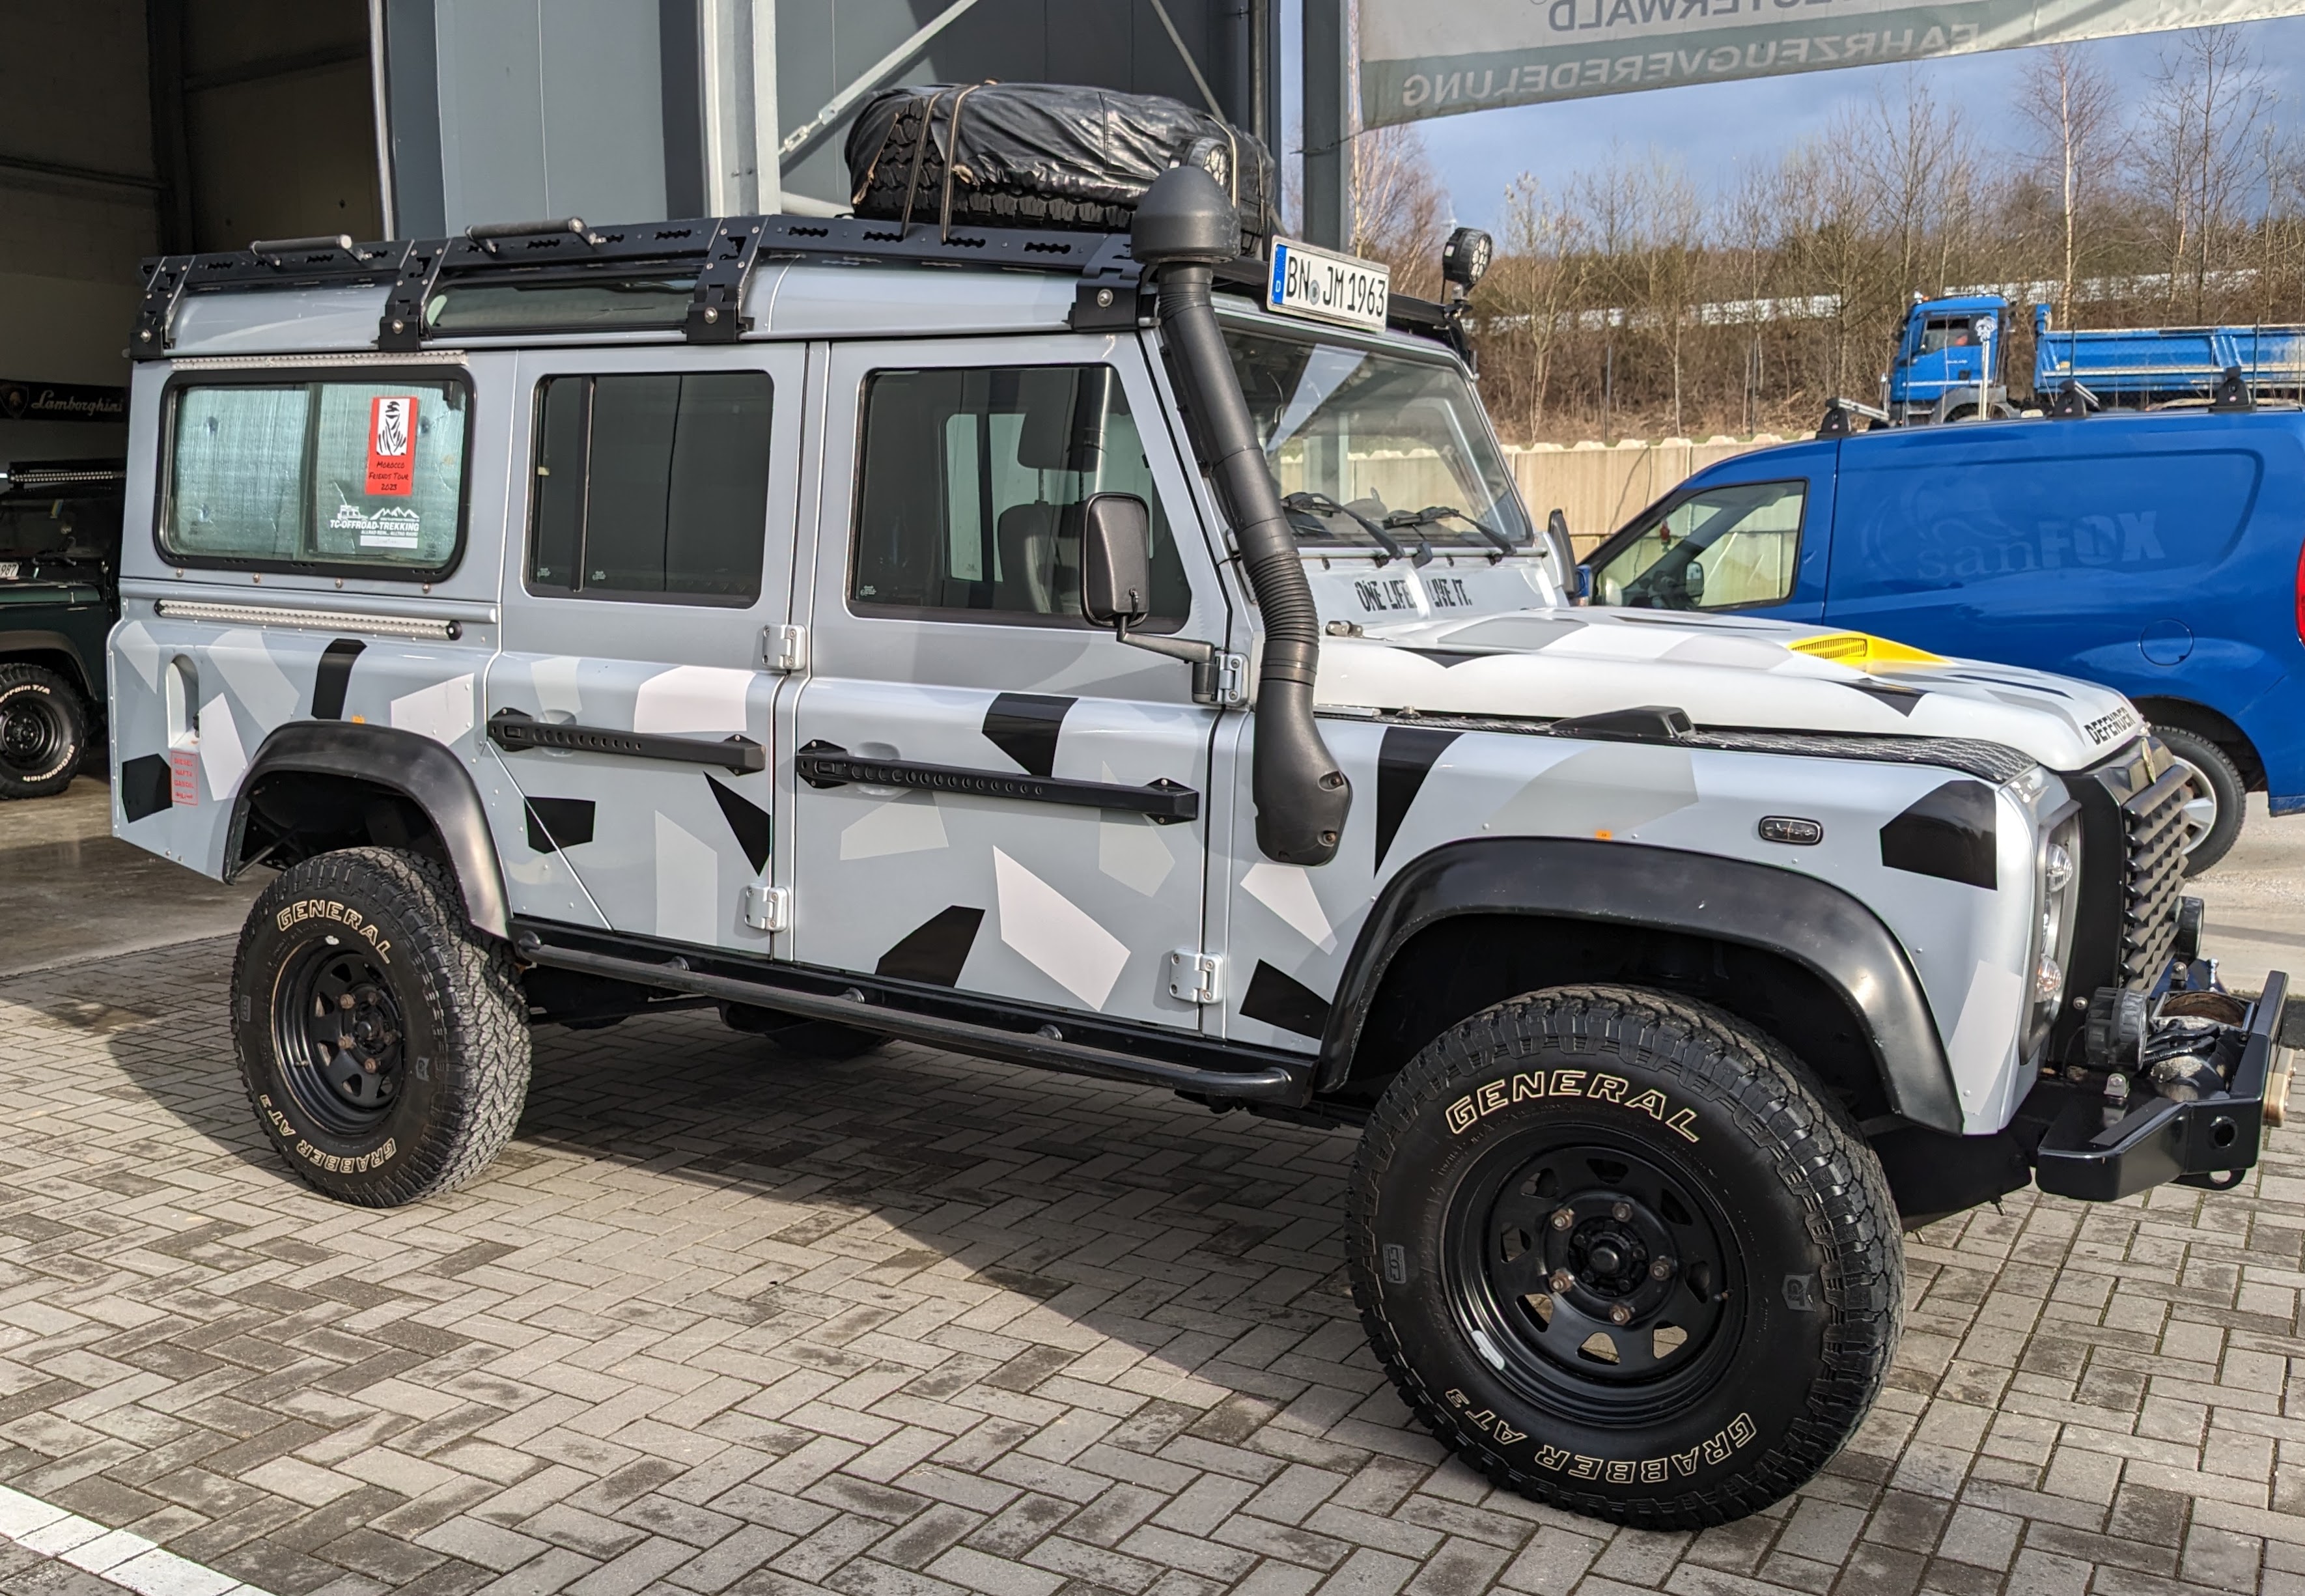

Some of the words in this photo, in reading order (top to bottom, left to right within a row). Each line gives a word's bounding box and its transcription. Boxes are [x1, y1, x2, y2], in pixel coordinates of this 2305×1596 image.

[1285, 256, 1311, 301] BN
[1322, 266, 1345, 309] JM
[1347, 272, 1386, 318] 1963
[31, 389, 124, 417] Lamborghini
[330, 520, 420, 531] TC-OFFROAD-TREKKING
[0, 564, 17, 576] 987
[1354, 580, 1387, 612] ONE
[1426, 579, 1456, 608] LIVE
[2084, 707, 2136, 745] DEFENDER
[277, 899, 391, 964] GENERAL
[1445, 1069, 1701, 1143] GENERAL
[296, 1138, 397, 1173] GRABBER
[1533, 1412, 1757, 1484] GRABBER
